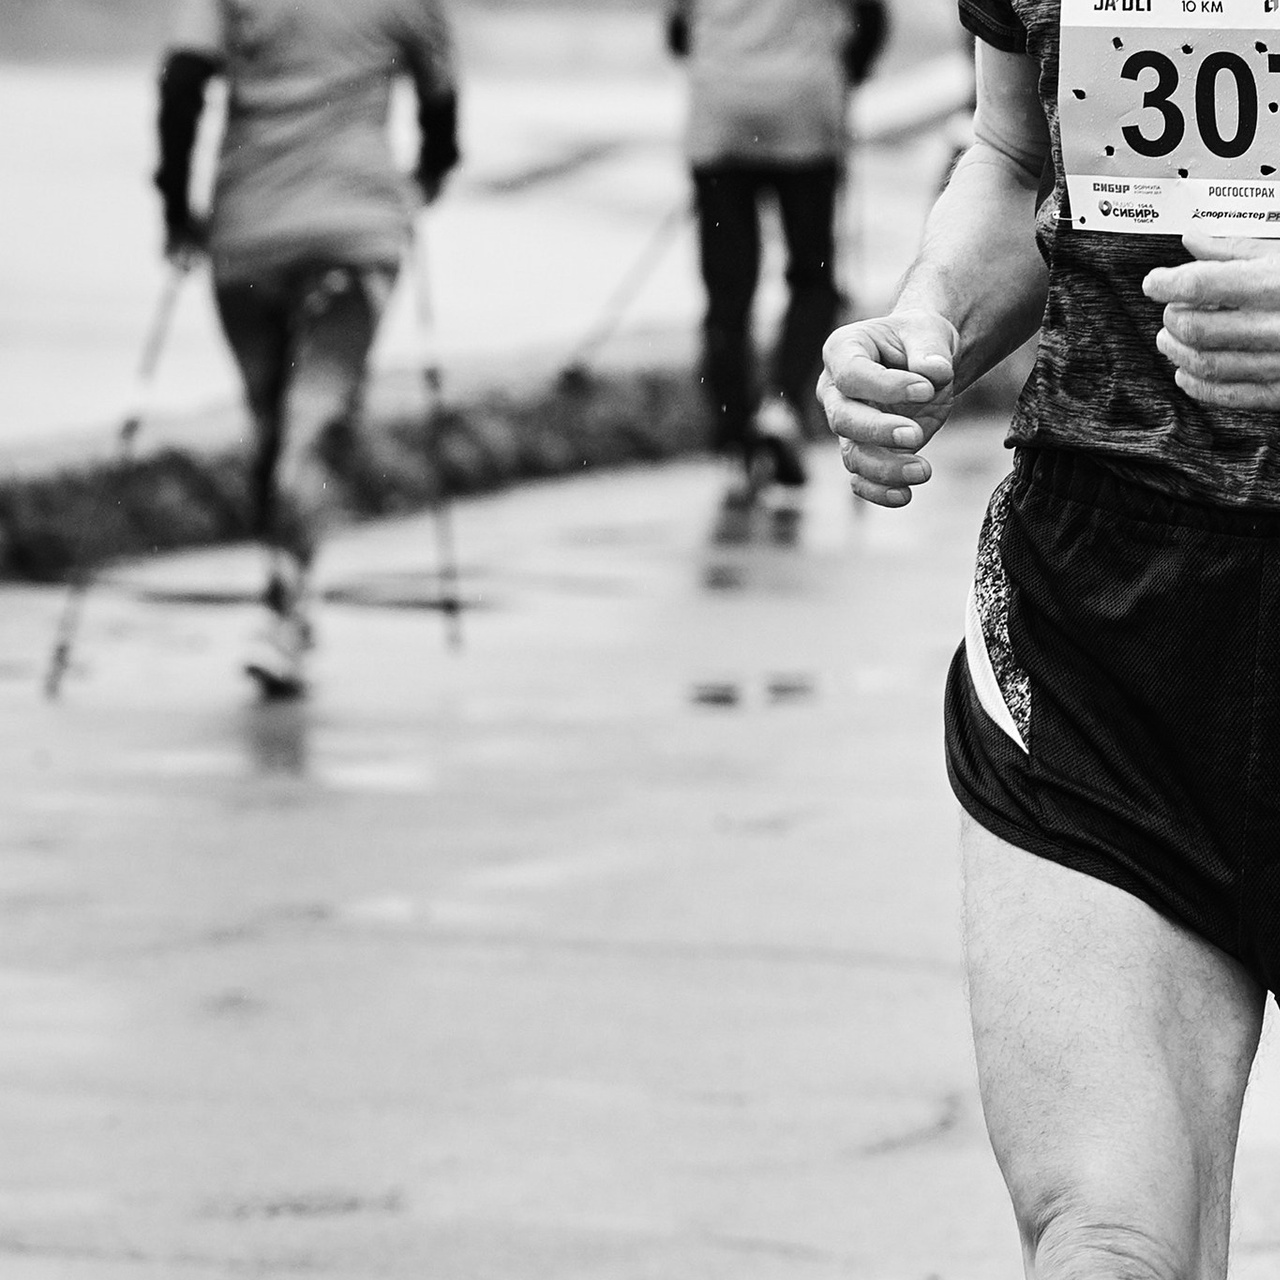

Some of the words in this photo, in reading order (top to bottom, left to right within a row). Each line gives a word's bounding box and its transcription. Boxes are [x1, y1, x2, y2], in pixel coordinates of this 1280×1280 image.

[1181, 0, 1197, 13] 10
[1092, 182, 1131, 194] СИБУР
[1208, 186, 1275, 198] РОСГОССТРАХ
[1112, 207, 1160, 219] СИБИРЬ
